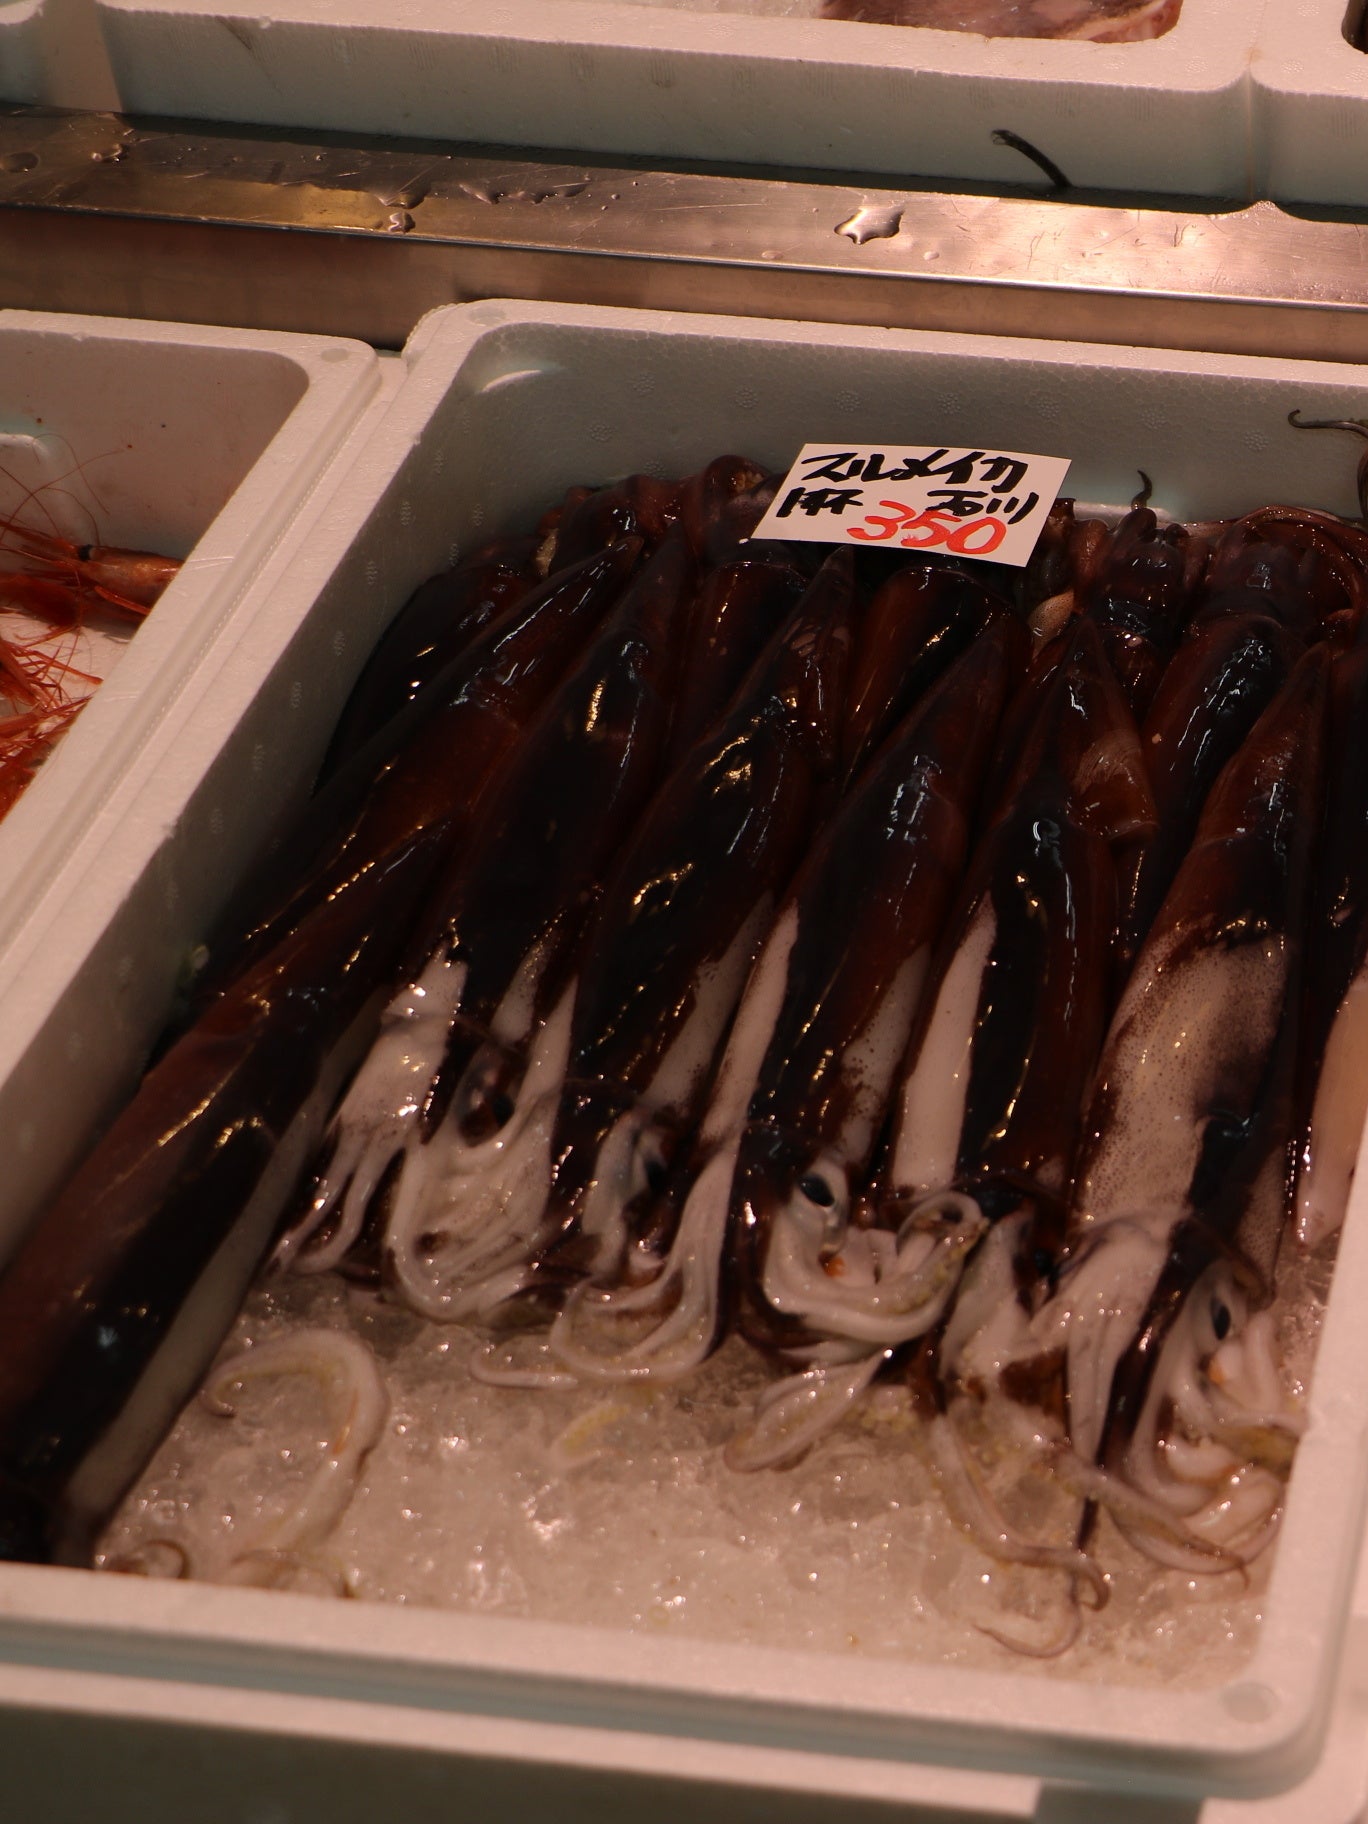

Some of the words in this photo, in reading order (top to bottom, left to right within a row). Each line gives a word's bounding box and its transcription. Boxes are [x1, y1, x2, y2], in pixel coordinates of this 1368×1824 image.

[801, 448, 1029, 493] スルメイカ
[847, 500, 1007, 554] 350
[925, 489, 1039, 525] 石川
